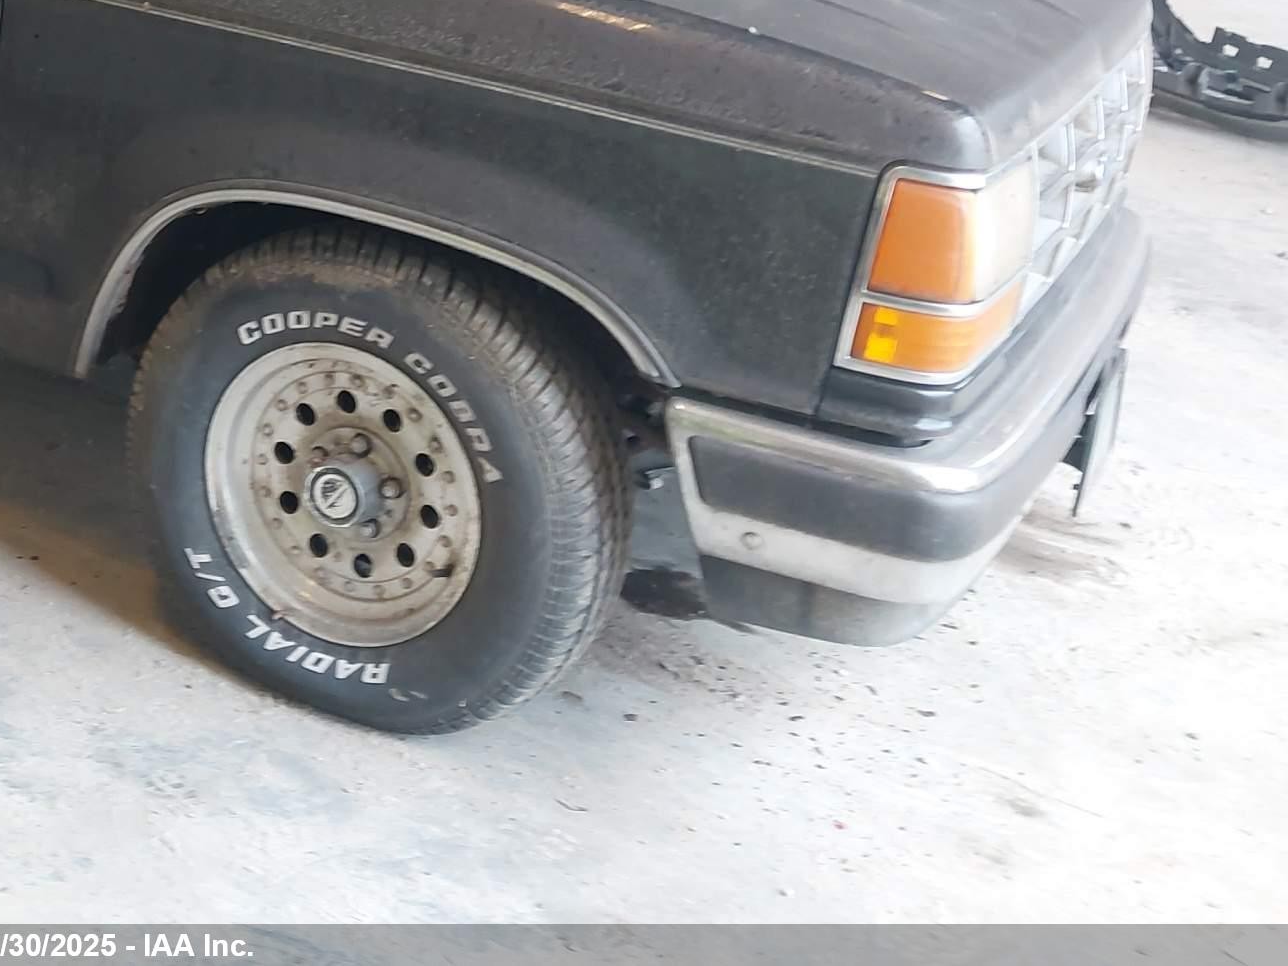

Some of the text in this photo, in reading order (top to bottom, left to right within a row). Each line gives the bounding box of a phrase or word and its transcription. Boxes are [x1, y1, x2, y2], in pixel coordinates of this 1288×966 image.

[237, 309, 503, 484] COOPER COBRA
[246, 614, 392, 684] RADIAL
